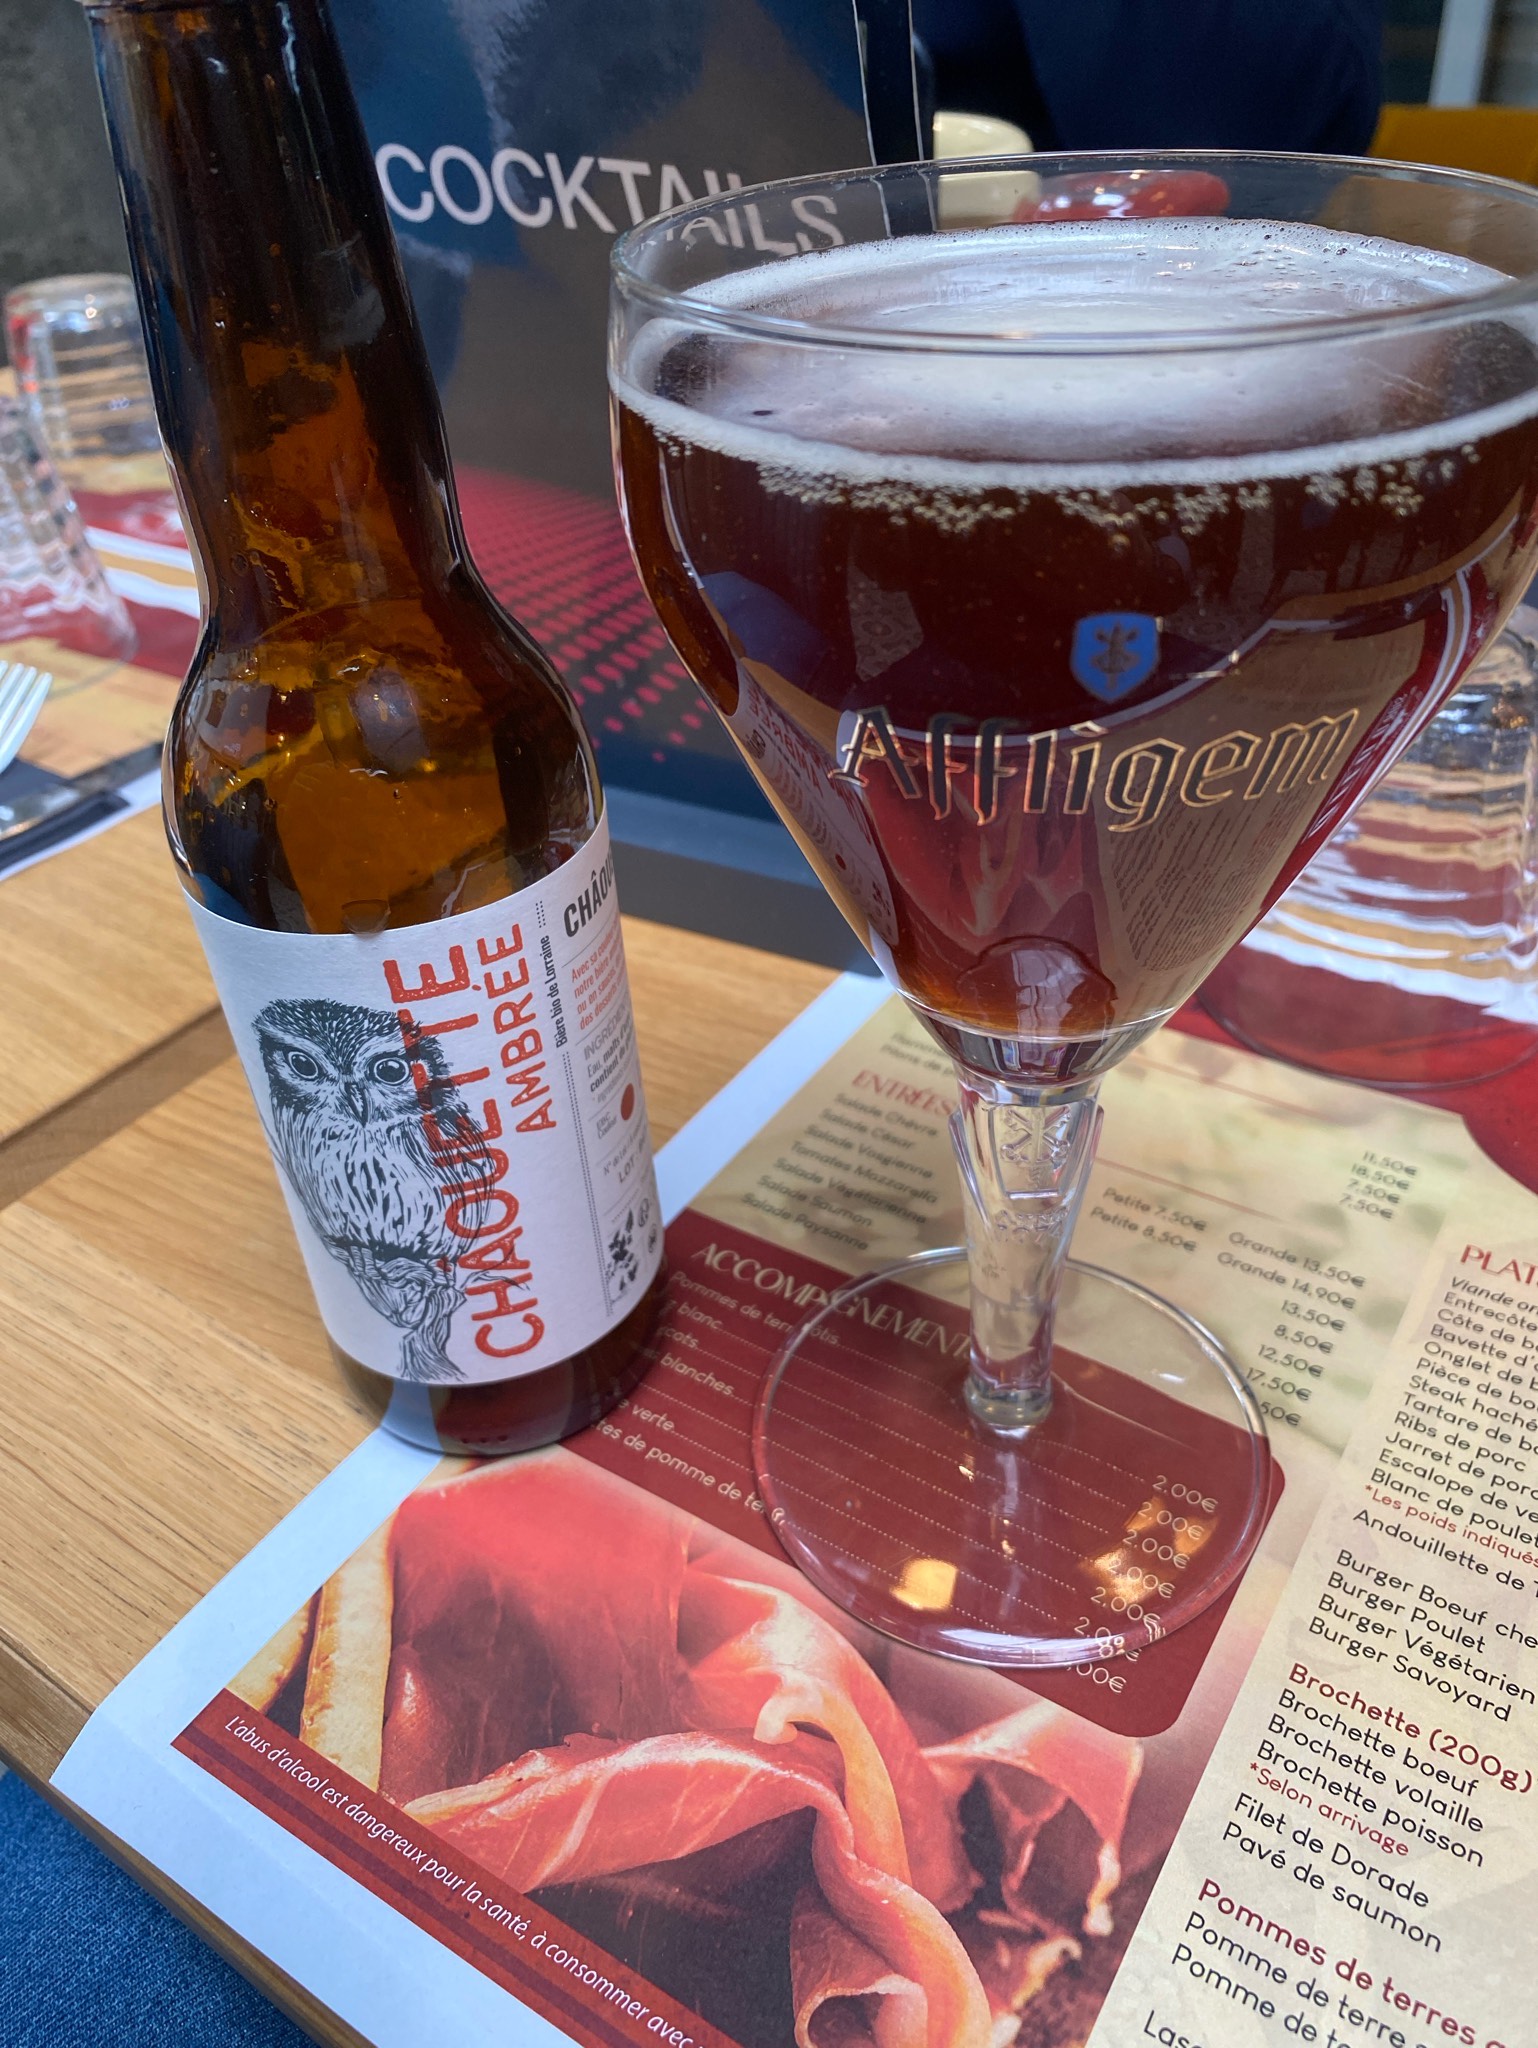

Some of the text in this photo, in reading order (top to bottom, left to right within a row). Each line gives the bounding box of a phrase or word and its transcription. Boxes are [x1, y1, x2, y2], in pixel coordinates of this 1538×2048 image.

[374, 142, 846, 257] COCKTAILS
[827, 706, 1360, 833] Affligem
[564, 853, 613, 938] CHÂOU
[540, 935, 568, 1048] Bière bio de Lorraine
[472, 923, 557, 1133] AMBRÉE
[835, 1092, 883, 1118] Salade
[852, 1070, 957, 1116] ENTRÉES
[820, 1108, 868, 1134] Salade
[773, 1157, 824, 1184] Salade
[791, 1140, 938, 1204] Tomates Mozzarella
[804, 1124, 934, 1179] Salade Vosgienne
[741, 1192, 869, 1251] Salade Paysanne
[757, 1175, 873, 1228] Salade Saumon
[1090, 1206, 1139, 1232] Petite
[1102, 1187, 1151, 1213] Petite
[1217, 1251, 1357, 1311] Grande 14.90€
[1228, 1231, 1367, 1289] Grande 13.50€
[1460, 1244, 1538, 1286] PLAT
[670, 1270, 739, 1310] Pommes
[740, 1304, 763, 1320] de
[764, 1312, 795, 1334] terr
[809, 1324, 840, 1346] ôtis
[677, 1302, 723, 1329] blanc
[1281, 1299, 1346, 1332] 13.50€
[1443, 1292, 1538, 1332] Entrecôte
[1451, 1276, 1514, 1305] Viande
[1273, 1324, 1334, 1354] 8.50€
[1430, 1323, 1508, 1360] Bavette
[1437, 1308, 1484, 1334] Côte
[1490, 1328, 1516, 1344] de
[660, 1352, 734, 1396] blanches
[1258, 1344, 1324, 1378] 12.50€
[1416, 1357, 1538, 1411] Pièce de bo
[1424, 1341, 1493, 1374] Onglet
[1497, 1368, 1524, 1386] de
[632, 1404, 675, 1432] verte
[1260, 1400, 1302, 1427] 50€
[1404, 1392, 1479, 1432] Tartare
[1485, 1426, 1513, 1444] de
[1409, 1374, 1538, 1433] Steak haché
[623, 1433, 647, 1451] de
[645, 1447, 716, 1487] pomme
[718, 1481, 742, 1500] de
[1386, 1431, 1453, 1466] Jarret
[1458, 1460, 1486, 1478] de
[1394, 1411, 1527, 1472] Ribs de porc
[1152, 1474, 1218, 1513] 2.00€
[1371, 1467, 1431, 1503] Blanc
[1436, 1497, 1465, 1516] de
[1379, 1448, 1538, 1523] Escalope de ve
[1405, 1505, 1458, 1533] poids
[1122, 1529, 1190, 1568] 2.00€
[1353, 1509, 1489, 1576] Andouillette
[1496, 1569, 1526, 1591] de
[1327, 1570, 1487, 1654] Burger Poulet
[1336, 1549, 1415, 1593] Burger
[1418, 1584, 1489, 1626] Boeuf
[1495, 1623, 1538, 1649] che
[1308, 1616, 1512, 1722] Burger Savoyard
[1318, 1593, 1536, 1705] Burger Végétarien
[1278, 1688, 1479, 1797] Brochette boeuf
[1289, 1663, 1533, 1793] Brochette (200g)
[1268, 1713, 1484, 1833] Brochette volaille
[1257, 1739, 1484, 1868] Brochette poisson
[1318, 1802, 1410, 1857] arrivage
[1234, 1792, 1430, 1909] Filet de Dorade
[225, 1715, 694, 2048] L'abus d'alcool est dangereux pour la santé, à consommer avec
[1223, 1821, 1443, 1953] Pavé de saumon
[1184, 1910, 1407, 2048] Pomme de terre
[1199, 1878, 1477, 2047] Pommes de terres
[1172, 1943, 1318, 2043] Pomme de
[1143, 2009, 1203, 2048] Las
